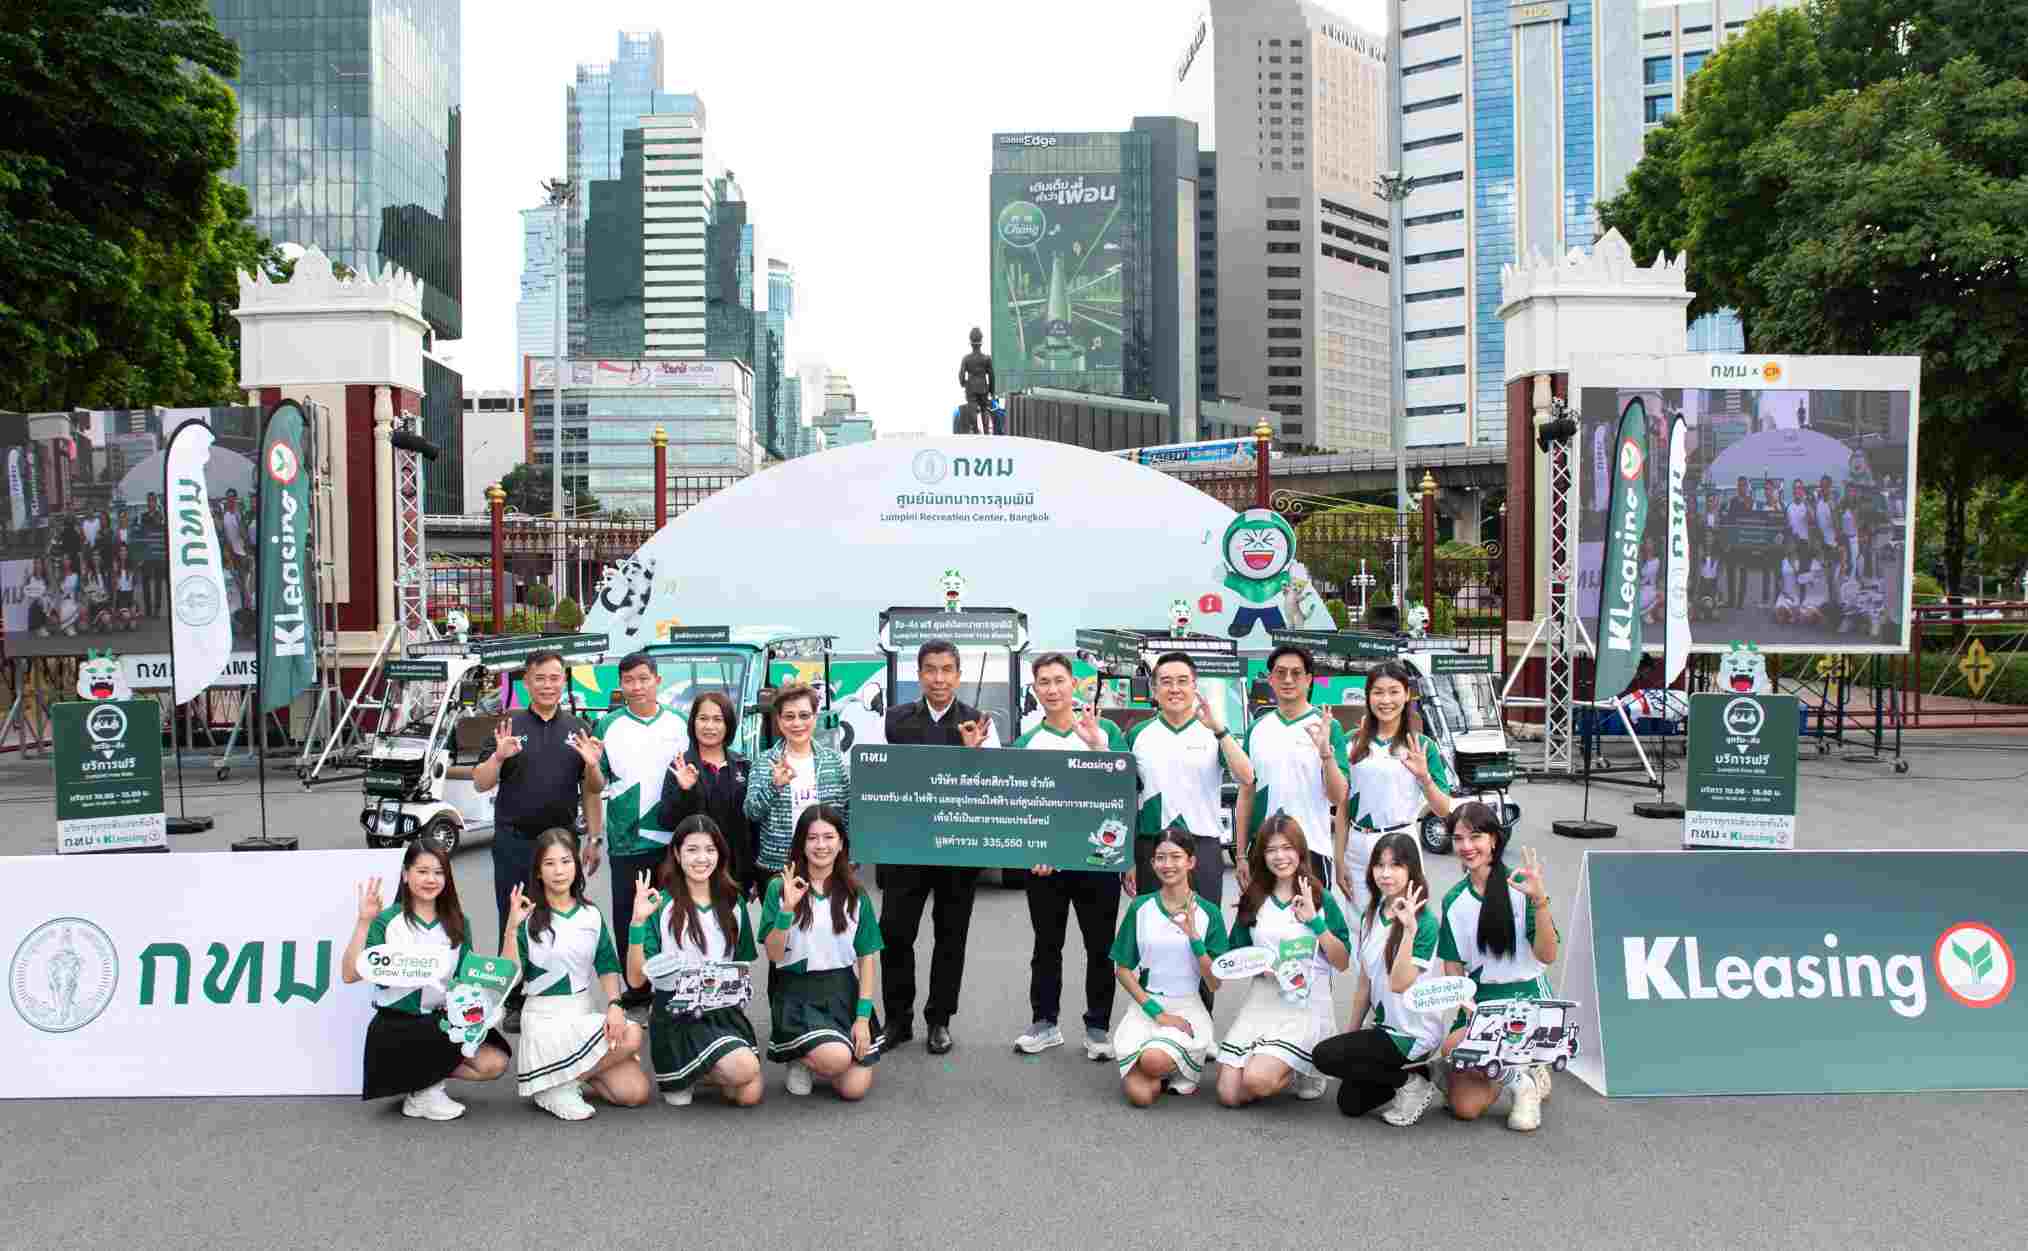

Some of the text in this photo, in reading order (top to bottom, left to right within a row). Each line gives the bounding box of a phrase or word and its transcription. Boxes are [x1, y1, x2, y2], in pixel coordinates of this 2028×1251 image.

[953, 457, 1014, 477] กทม
[174, 477, 210, 569] กทม
[880, 512, 918, 523] Lumpini
[919, 512, 970, 522] Recreation
[1008, 512, 1050, 523] Bangkok
[271, 489, 305, 657] KLeasing
[1607, 486, 1641, 651] KLeasing
[82, 756, 136, 771] บริการฟรี
[860, 752, 887, 763] กทม
[1068, 757, 1114, 771] KLeasing
[1714, 752, 1770, 766] บริการฟรี
[982, 837, 1023, 850] 335,550
[1027, 838, 1047, 849] บาท
[367, 951, 440, 968] GoGreen
[137, 939, 333, 1006] กทม
[1622, 932, 1928, 1018] KLeasing
